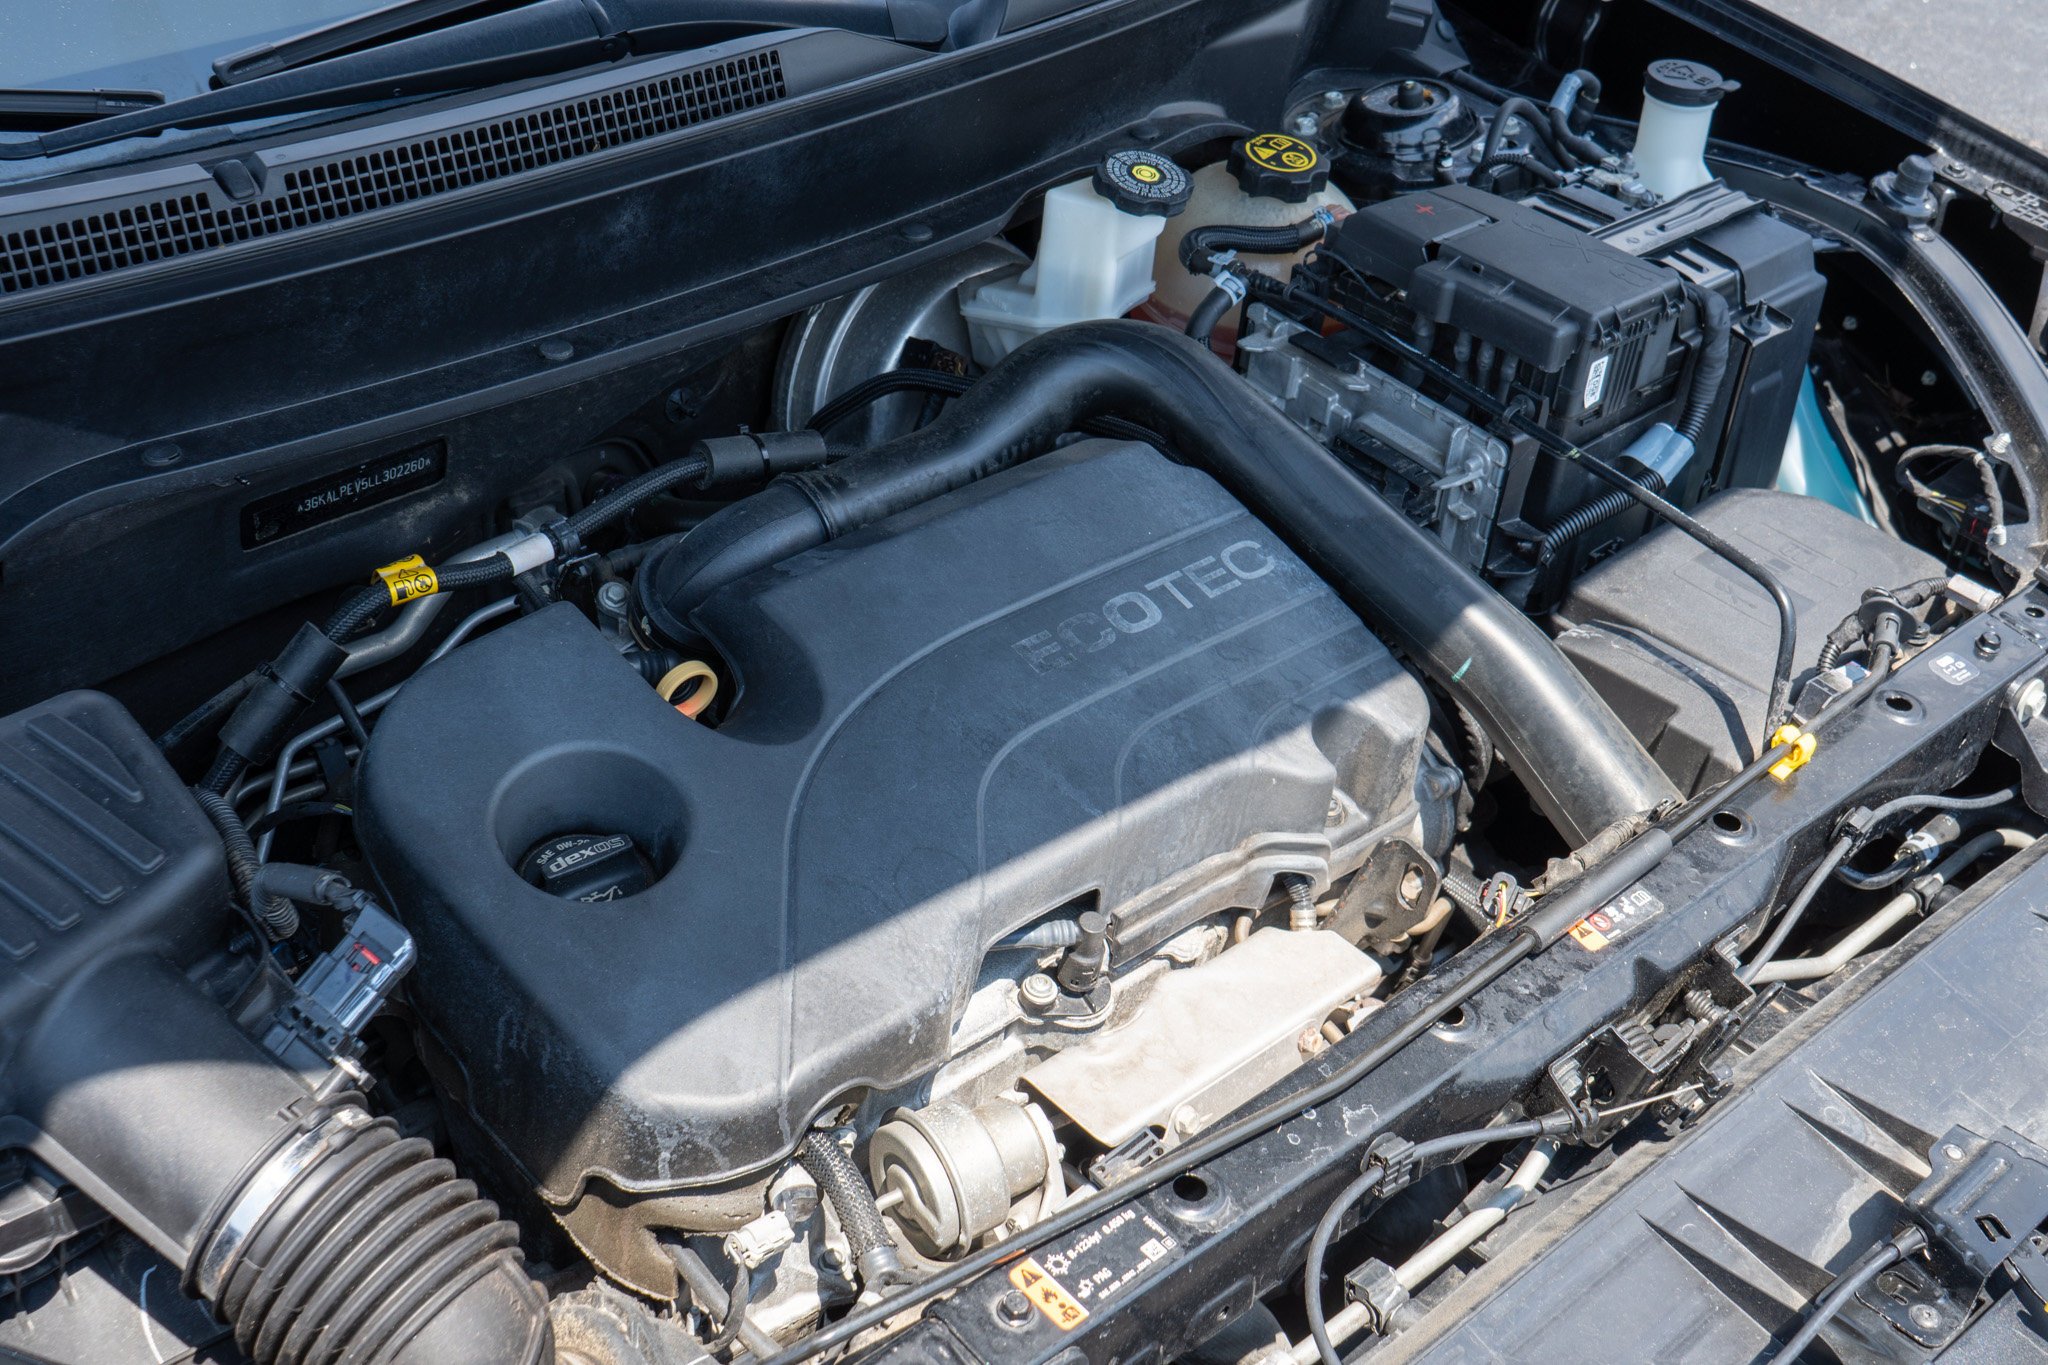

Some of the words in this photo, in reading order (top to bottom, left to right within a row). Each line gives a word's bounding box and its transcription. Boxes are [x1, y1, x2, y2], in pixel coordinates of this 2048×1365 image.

[1010, 540, 1275, 676] ECOTEC
[536, 849, 556, 866] SAE
[1092, 1266, 1113, 1284] PAG
